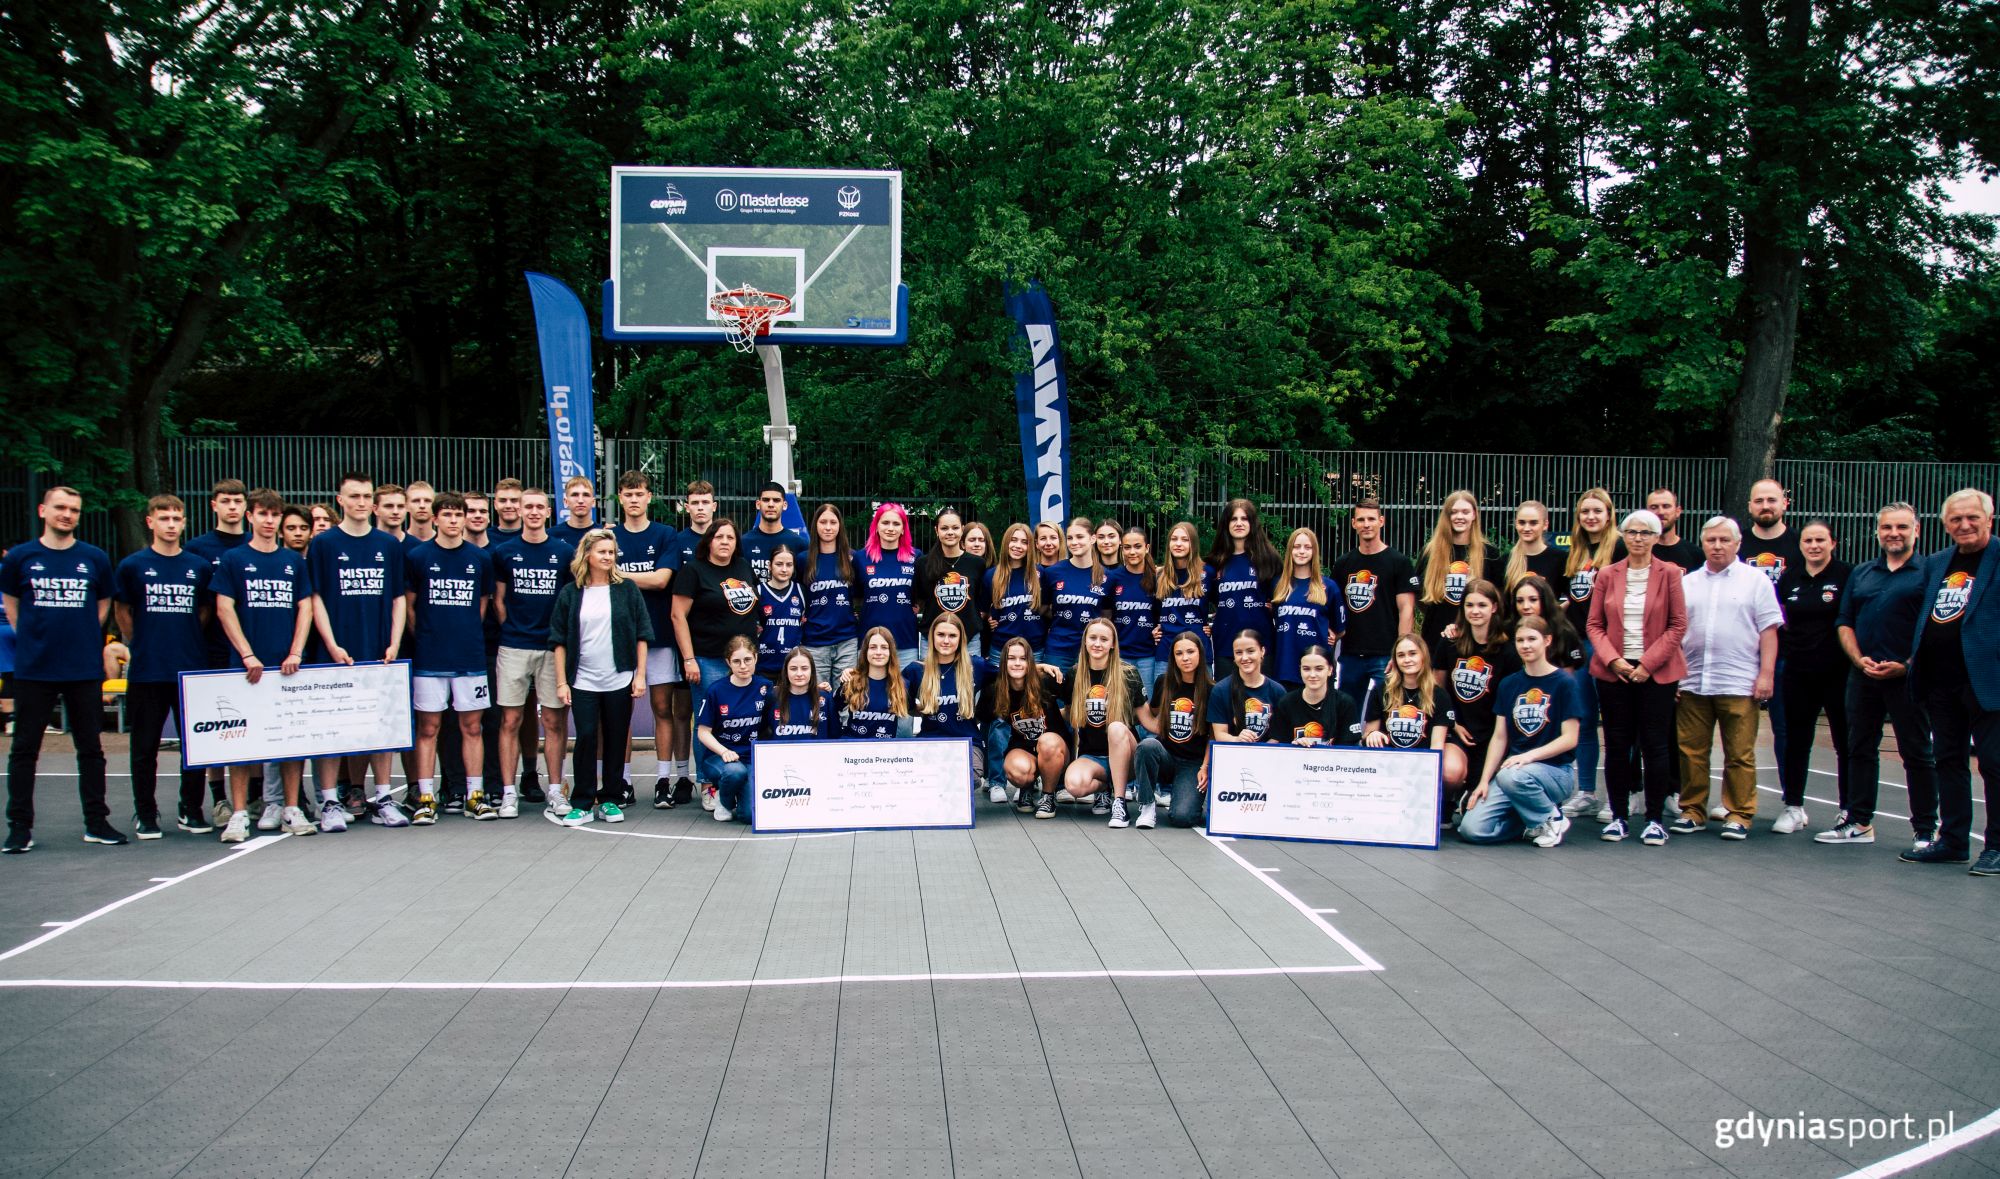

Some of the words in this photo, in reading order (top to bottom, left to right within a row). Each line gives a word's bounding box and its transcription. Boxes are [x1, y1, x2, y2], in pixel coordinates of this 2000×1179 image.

[740, 193, 809, 207] Masterlease
[666, 207, 686, 216] sport
[616, 560, 655, 572] MISTRZ
[751, 559, 771, 569] MIS
[339, 568, 384, 579] MISTRZ
[513, 568, 557, 579] MISTRZ
[30, 577, 89, 590] MISTRZ
[246, 579, 293, 591] MISTRZ
[429, 579, 474, 590] MISTRZ
[868, 578, 912, 588] GDYNIA
[1218, 581, 1258, 593] GDYNIA
[146, 583, 195, 596] MISTRZ
[936, 583, 967, 597] GTK
[1056, 594, 1098, 606] GDYNIA
[1115, 601, 1152, 611] GDYNIA
[1243, 602, 1264, 610] opec
[1278, 605, 1317, 618] GDYNIA
[766, 618, 776, 626] TK
[777, 626, 785, 646] 4
[1297, 628, 1317, 637] opec
[1452, 668, 1488, 687] GTK
[281, 684, 312, 694] Nagroda
[313, 682, 353, 692] Prezydenta
[475, 685, 488, 699] 20
[1456, 681, 1483, 692] GDYNIA
[852, 711, 895, 722] GDYNIA
[193, 718, 247, 733] GDYNIA
[1387, 718, 1424, 732] GTK
[219, 728, 247, 740] sport
[844, 757, 874, 766] Nagroda
[875, 756, 914, 765] Prezydenta
[1303, 763, 1334, 773] Nagroda
[1335, 765, 1377, 775] Prezydenta
[762, 787, 811, 799] GDYNIA
[1217, 791, 1267, 802] GDYNIA
[785, 796, 811, 808] sport
[1240, 801, 1266, 813] sport
